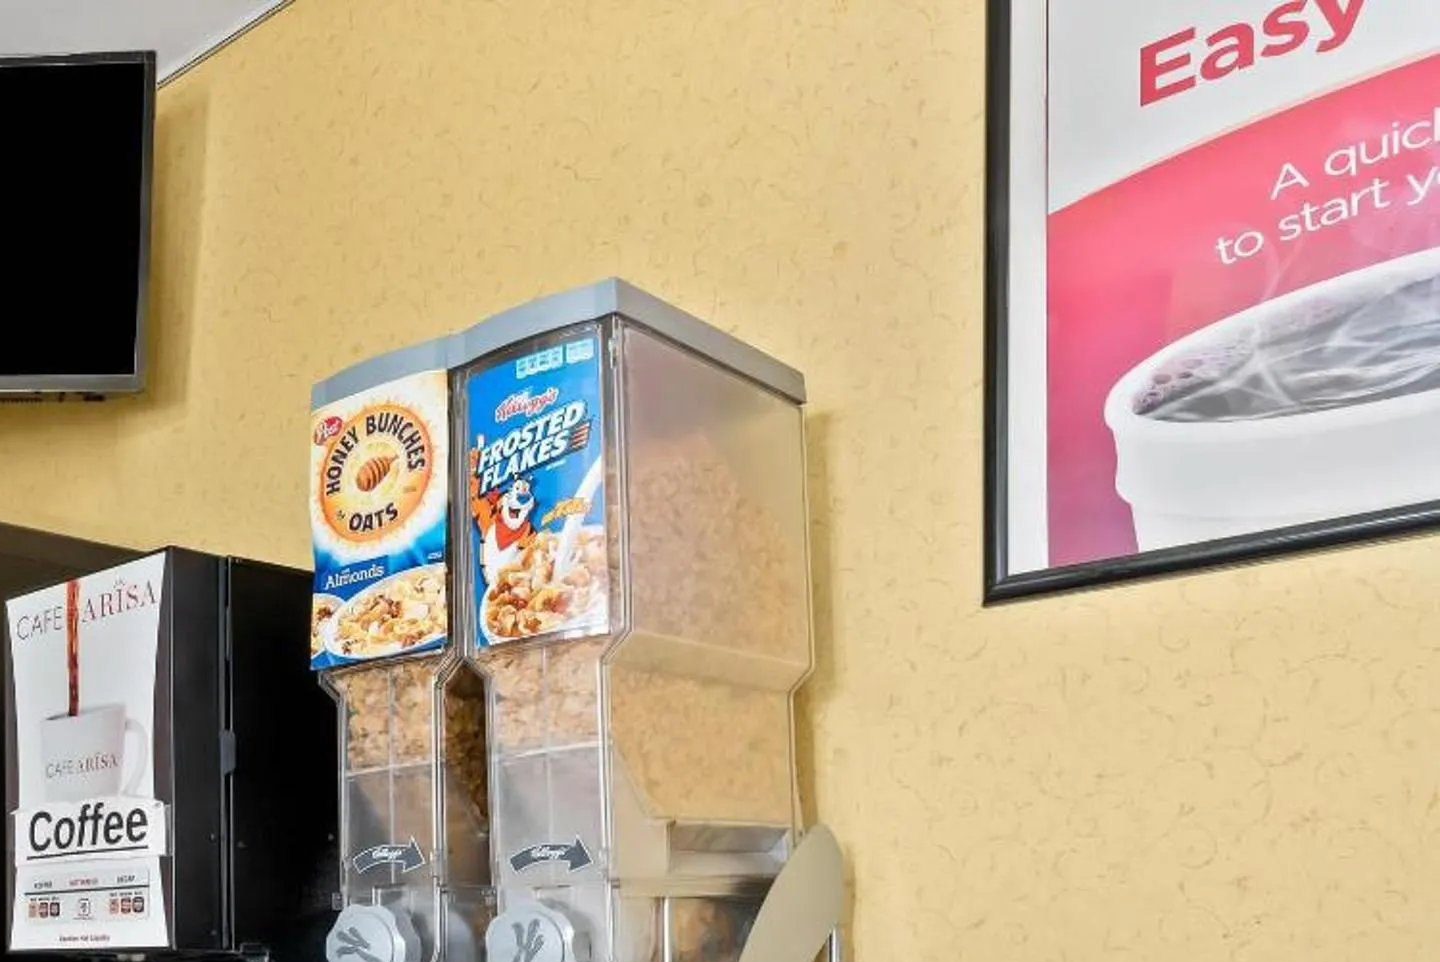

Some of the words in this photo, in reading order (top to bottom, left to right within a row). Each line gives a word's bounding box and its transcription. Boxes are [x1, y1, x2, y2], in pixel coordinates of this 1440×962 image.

[1140, 0, 1364, 106] Easy
[1270, 162, 1309, 200] A
[1216, 231, 1264, 265] to
[1278, 178, 1391, 241] start
[1406, 166, 1440, 205] y
[326, 426, 360, 496] HONEY
[366, 412, 426, 473] BUNCHES
[478, 402, 587, 475] FROSTED
[480, 429, 569, 495] FLAKES
[349, 502, 398, 532] OATS
[324, 563, 385, 590] Almonds
[29, 802, 148, 851] Coffee
